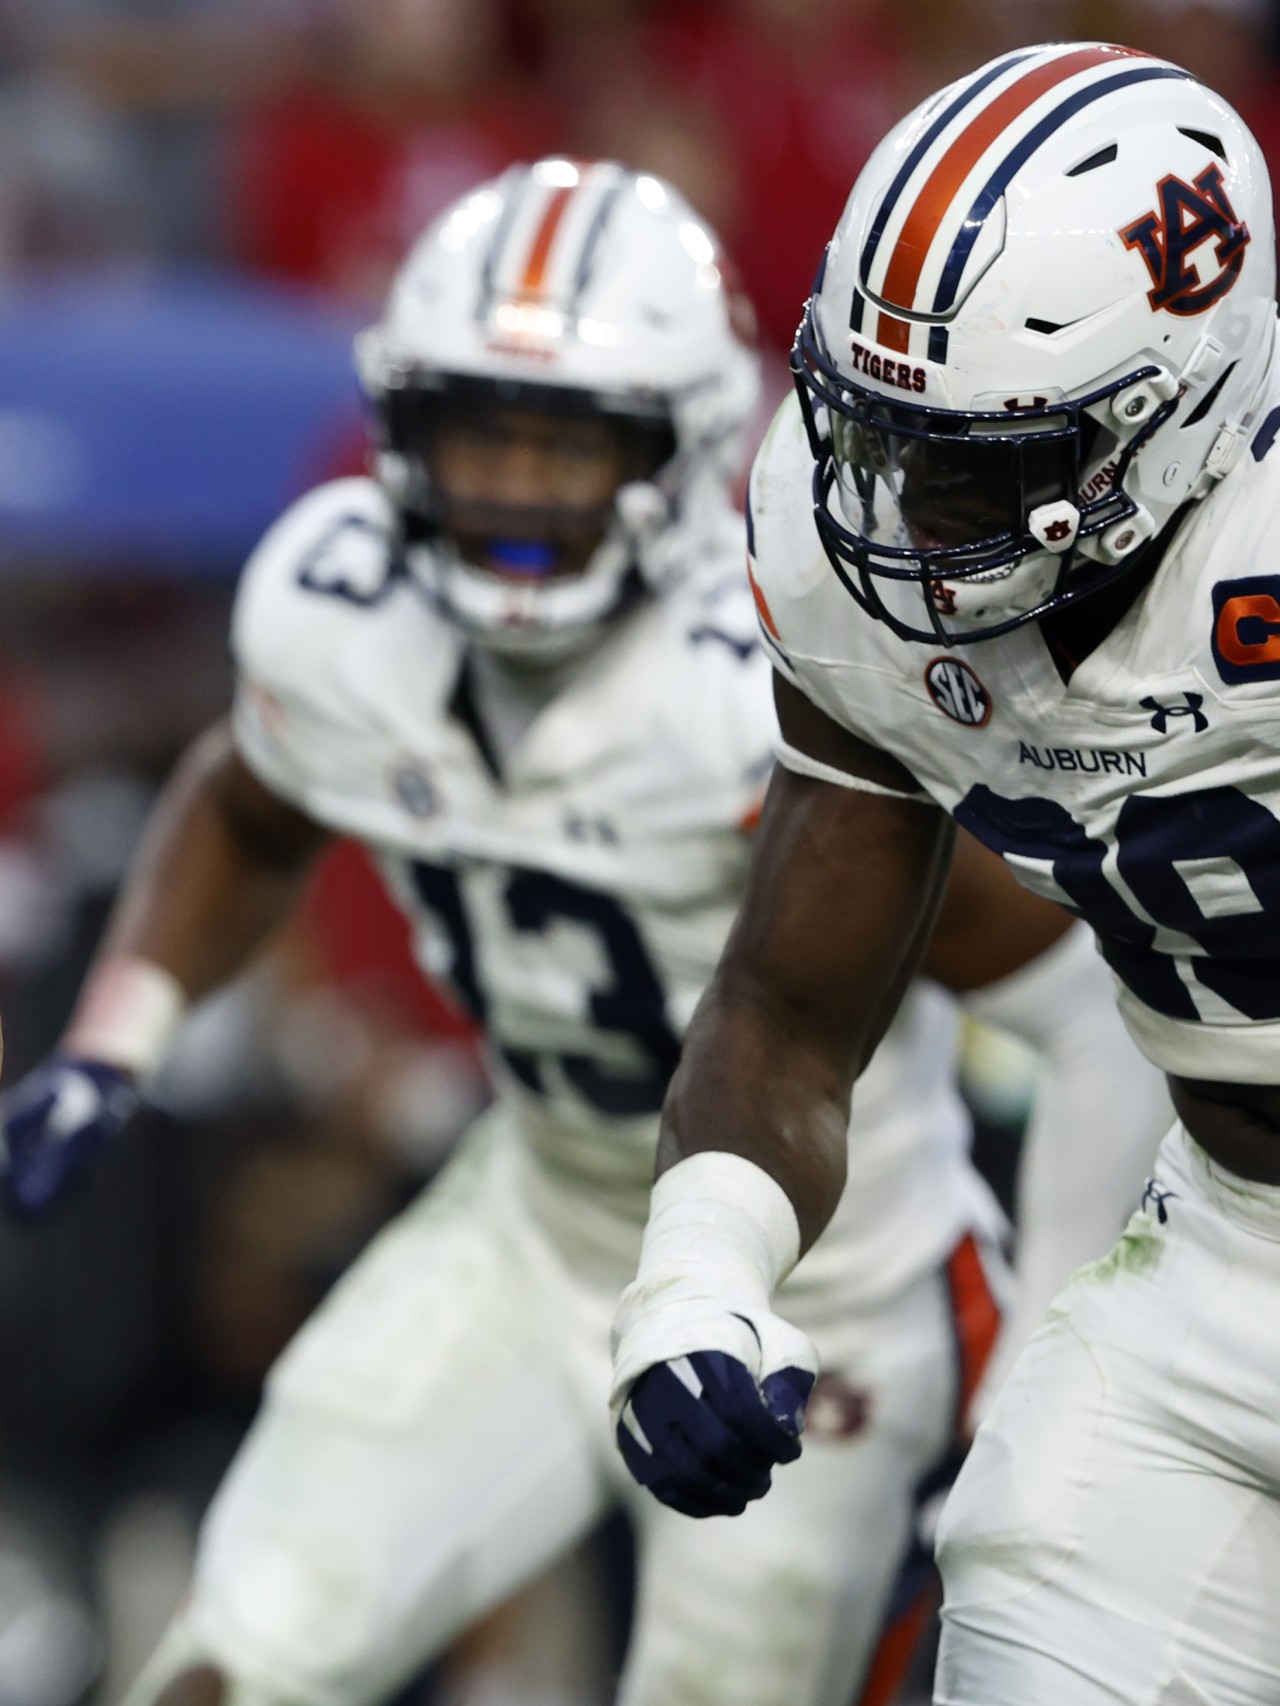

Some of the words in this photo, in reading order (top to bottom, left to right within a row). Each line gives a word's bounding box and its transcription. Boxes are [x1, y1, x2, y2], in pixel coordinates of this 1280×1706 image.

[851, 342, 927, 393] TIGERS
[1218, 594, 1280, 666] C
[929, 662, 987, 724] SEC
[1019, 742, 1147, 777] AUBURN
[408, 857, 686, 1116] 13
